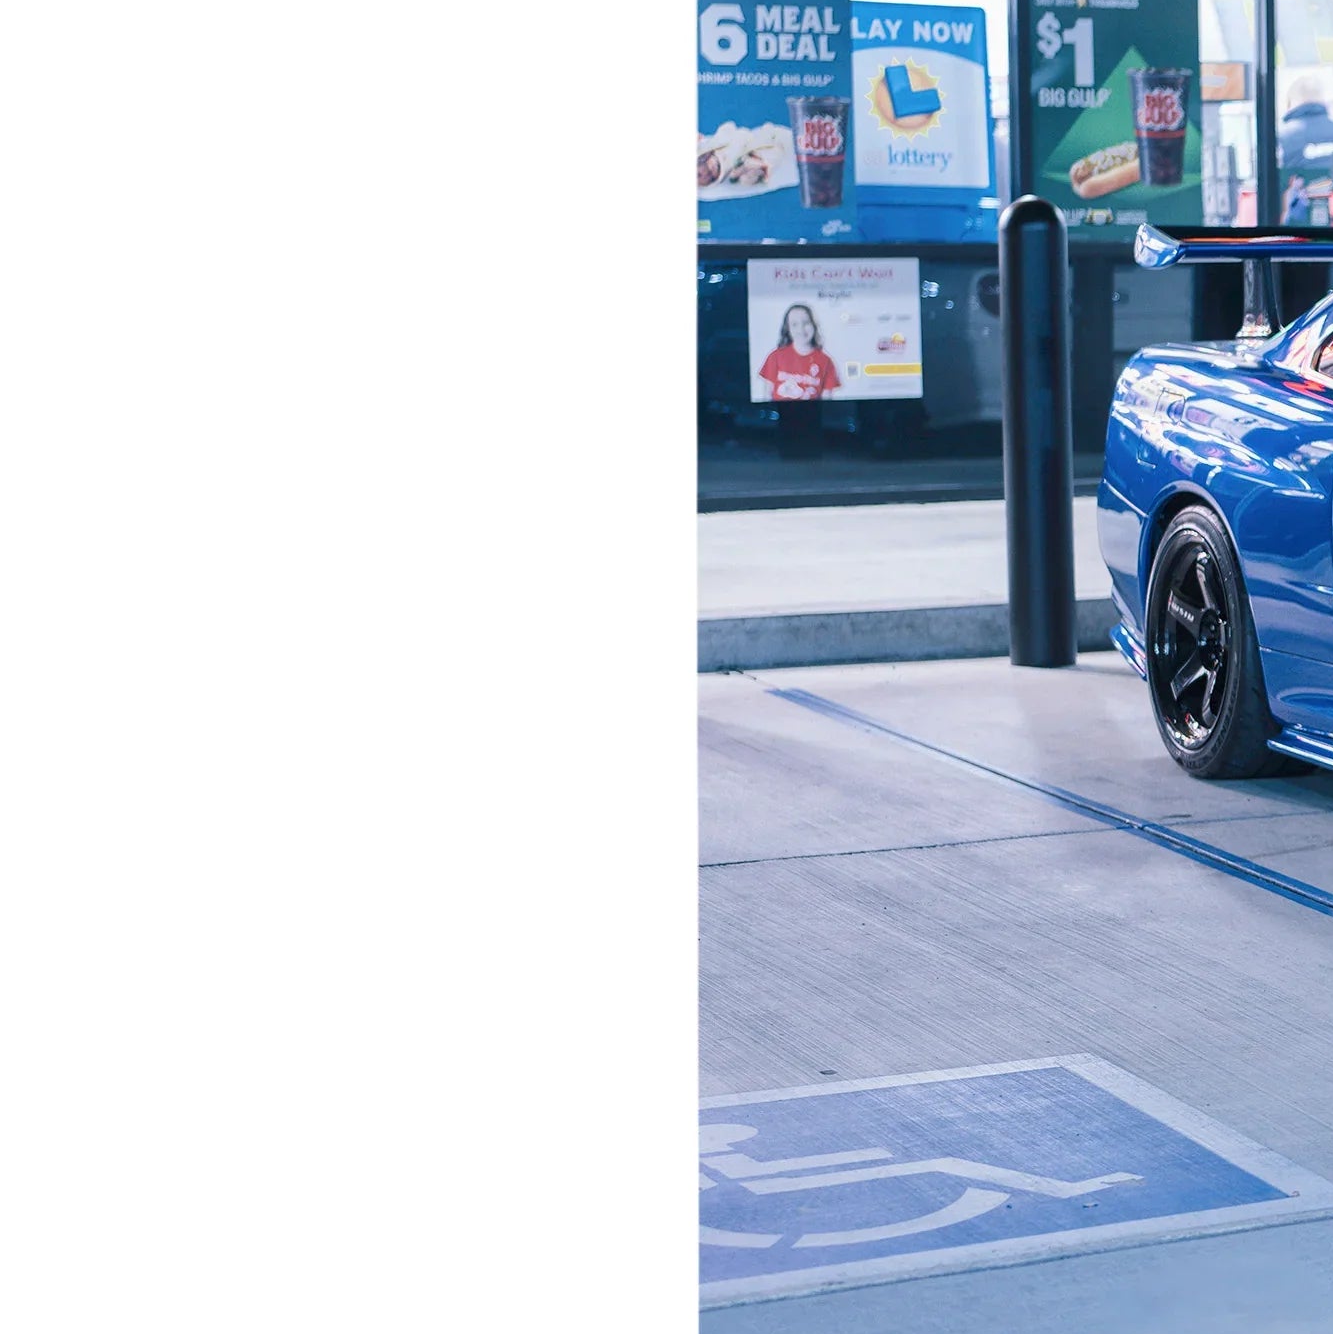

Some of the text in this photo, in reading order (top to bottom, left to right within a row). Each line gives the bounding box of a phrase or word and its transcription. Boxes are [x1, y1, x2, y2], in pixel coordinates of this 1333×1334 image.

[755, 4, 841, 34] MEAL
[851, 17, 973, 44] LAY NOW
[757, 33, 836, 62] DEAL
[1036, 11, 1094, 87] $1
[696, 71, 734, 84] HRIMP
[736, 72, 769, 85] TACOS
[1038, 87, 1065, 107] BIG
[888, 144, 950, 171] lottery
